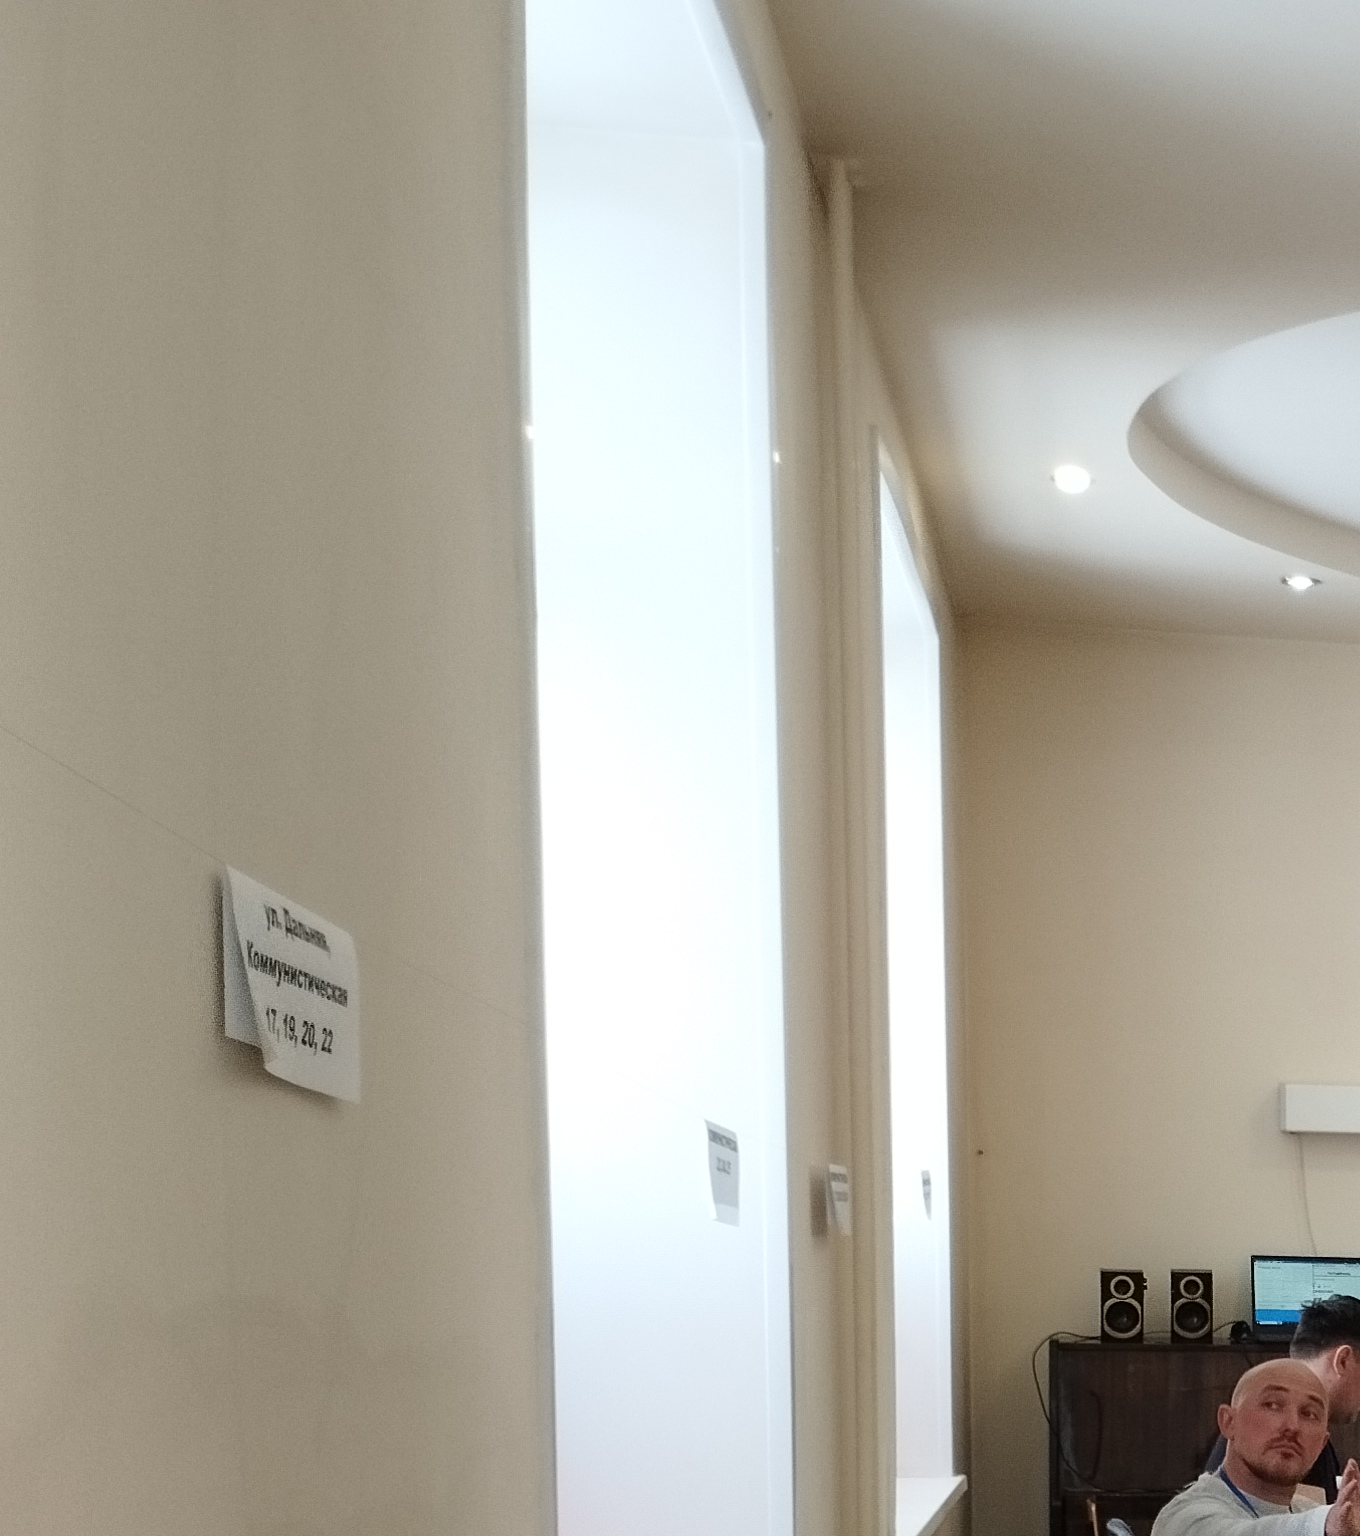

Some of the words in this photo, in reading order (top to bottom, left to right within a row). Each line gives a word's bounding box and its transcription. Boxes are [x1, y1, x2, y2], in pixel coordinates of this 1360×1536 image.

[263, 904, 282, 931] ул.
[265, 1007, 280, 1043] 17,
[283, 1012, 298, 1048] 19,
[301, 1020, 318, 1056] 20,
[321, 1027, 334, 1055] 22
